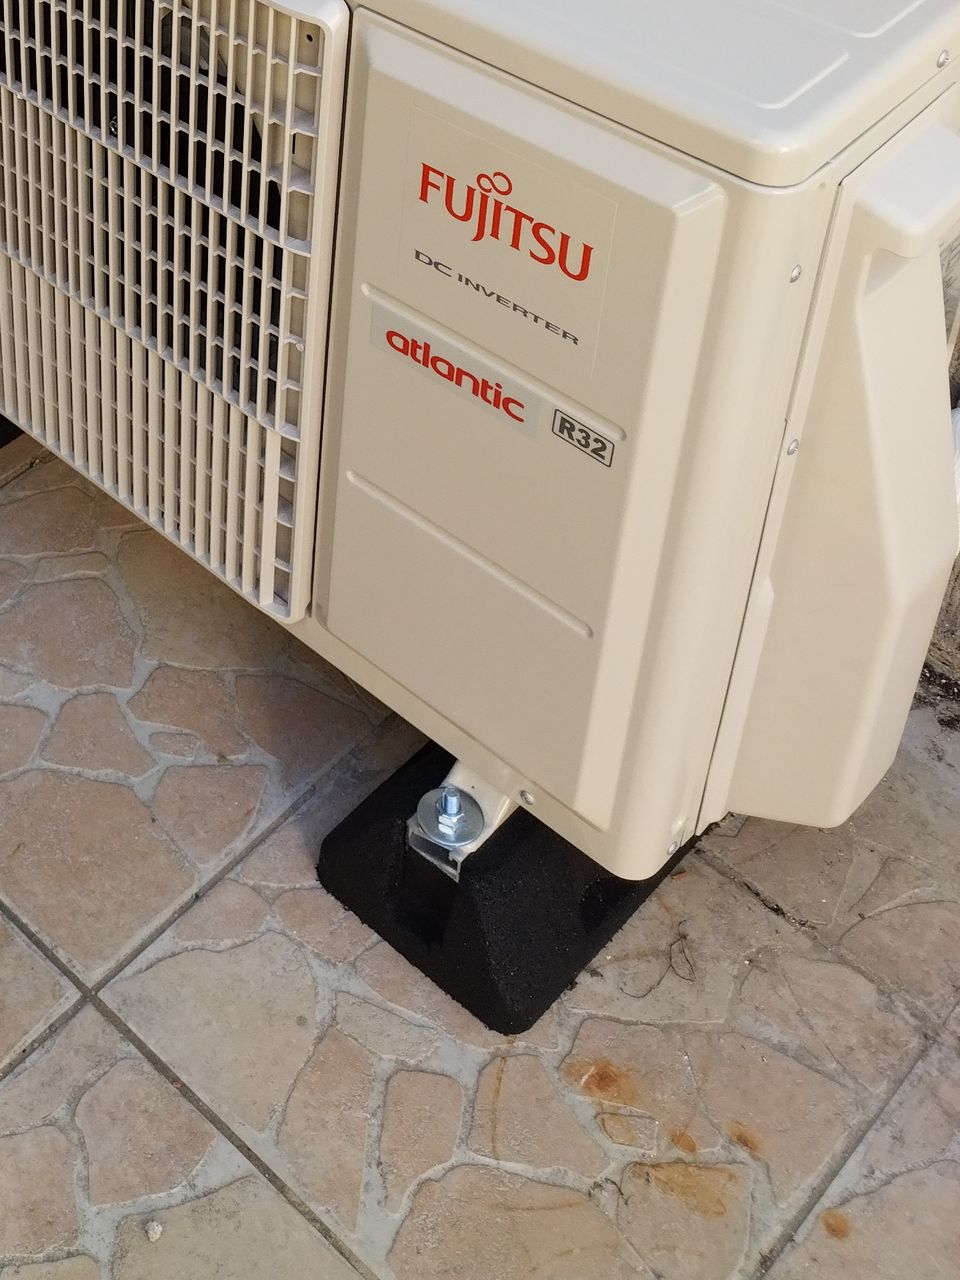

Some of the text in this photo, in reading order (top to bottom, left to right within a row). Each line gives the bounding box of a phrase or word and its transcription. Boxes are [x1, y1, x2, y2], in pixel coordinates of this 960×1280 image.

[418, 161, 594, 282] FUJITSU
[413, 248, 580, 346] DC INVERTER
[385, 329, 607, 461] atlantic R32
